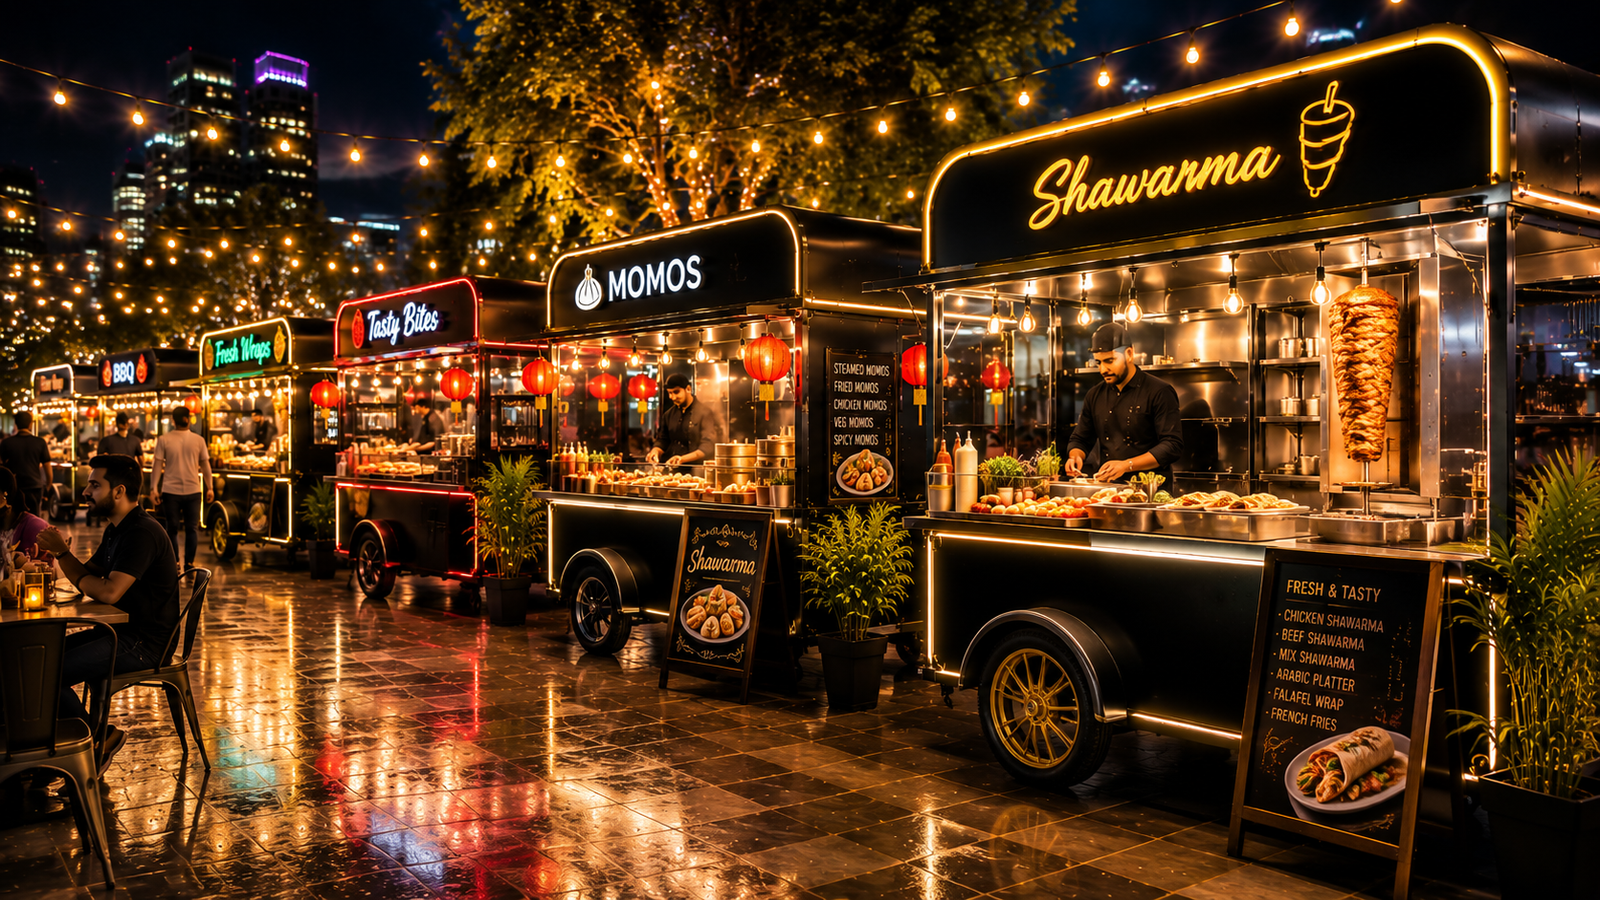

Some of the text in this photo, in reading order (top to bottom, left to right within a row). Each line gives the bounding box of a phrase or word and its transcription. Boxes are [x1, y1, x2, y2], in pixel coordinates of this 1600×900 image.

[1028, 145, 1281, 230] Shawarma
[608, 254, 702, 302] MOMOS
[367, 301, 438, 346] Tasty Bites
[215, 333, 271, 367] Fresh Wraps
[113, 361, 135, 385] BBQ
[833, 362, 890, 377] STEAMED MOMOS
[833, 380, 879, 394] FRIED MOMOS
[833, 398, 888, 411] CHICKEN MOMOS
[833, 416, 874, 428] VEG MOMOS
[833, 434, 879, 446] SPICY MOMOS
[687, 545, 757, 576] Shawarma
[1286, 579, 1382, 603] FRESH & TASTY
[1283, 608, 1384, 633] CHICKEN SHAWARMA
[1281, 628, 1365, 652] BEEF SHAWARMA
[1278, 647, 1356, 672] MIX SHAWARMA
[1275, 667, 1356, 693] ARABIC PLATTER
[1273, 687, 1344, 711] FALAFEL WRAP
[1270, 706, 1338, 732] FRENCH FRIES
